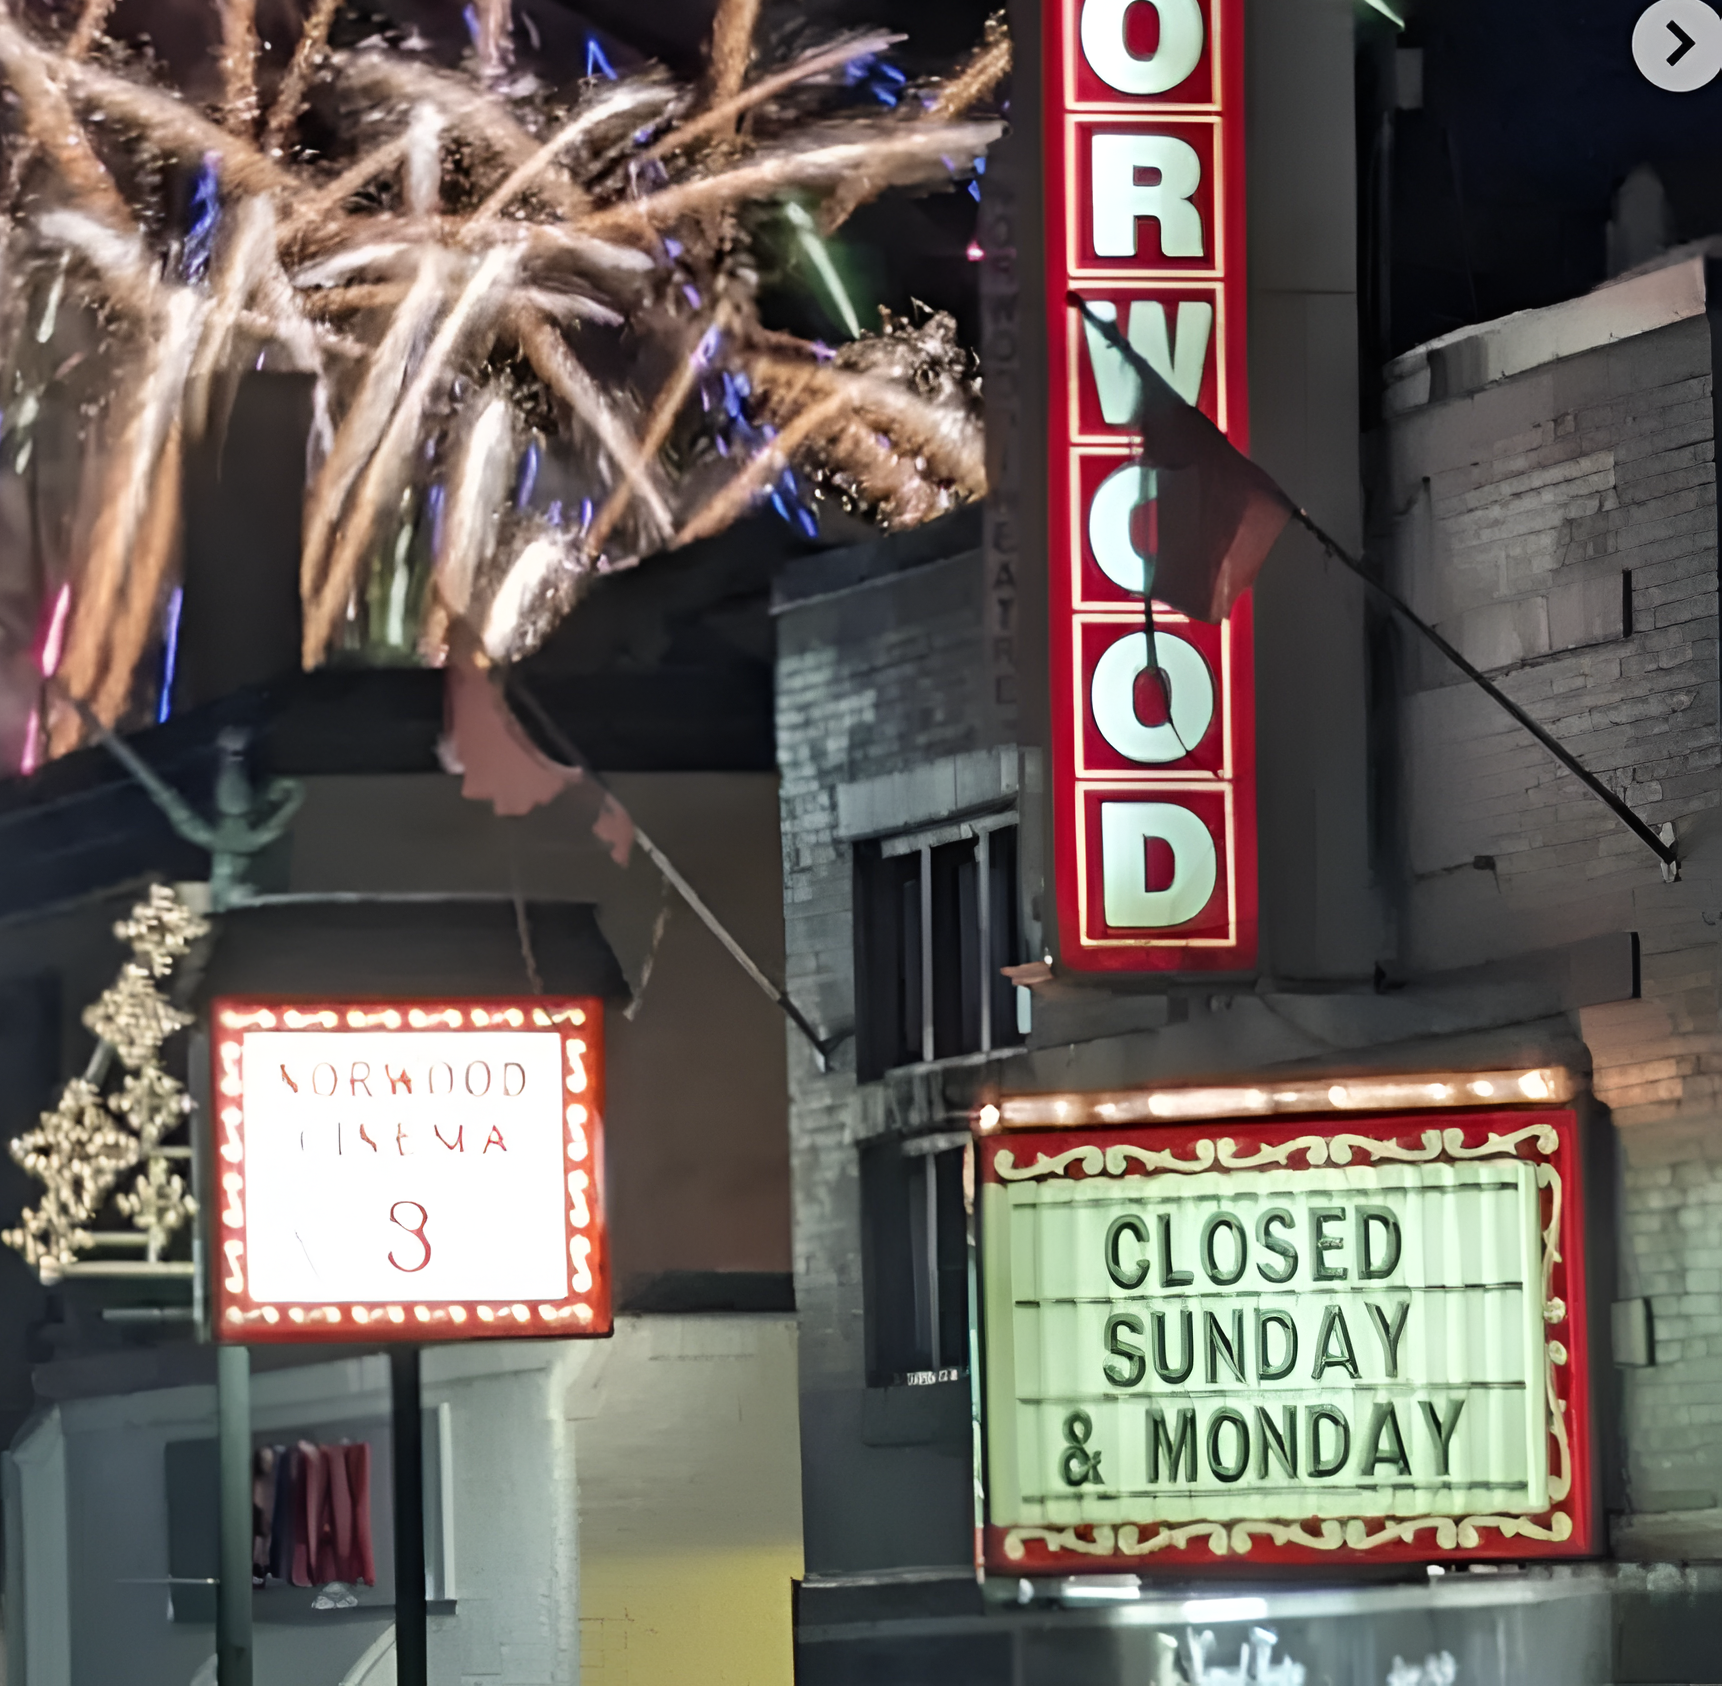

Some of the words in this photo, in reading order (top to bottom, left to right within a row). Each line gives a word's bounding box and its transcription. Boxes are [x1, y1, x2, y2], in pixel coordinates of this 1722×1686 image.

[1104, 1204, 1404, 1290] CLOSED
[1102, 1301, 1410, 1388] SUNDAY
[1058, 1408, 1104, 1488] &
[1146, 1398, 1466, 1485] MONDAY
